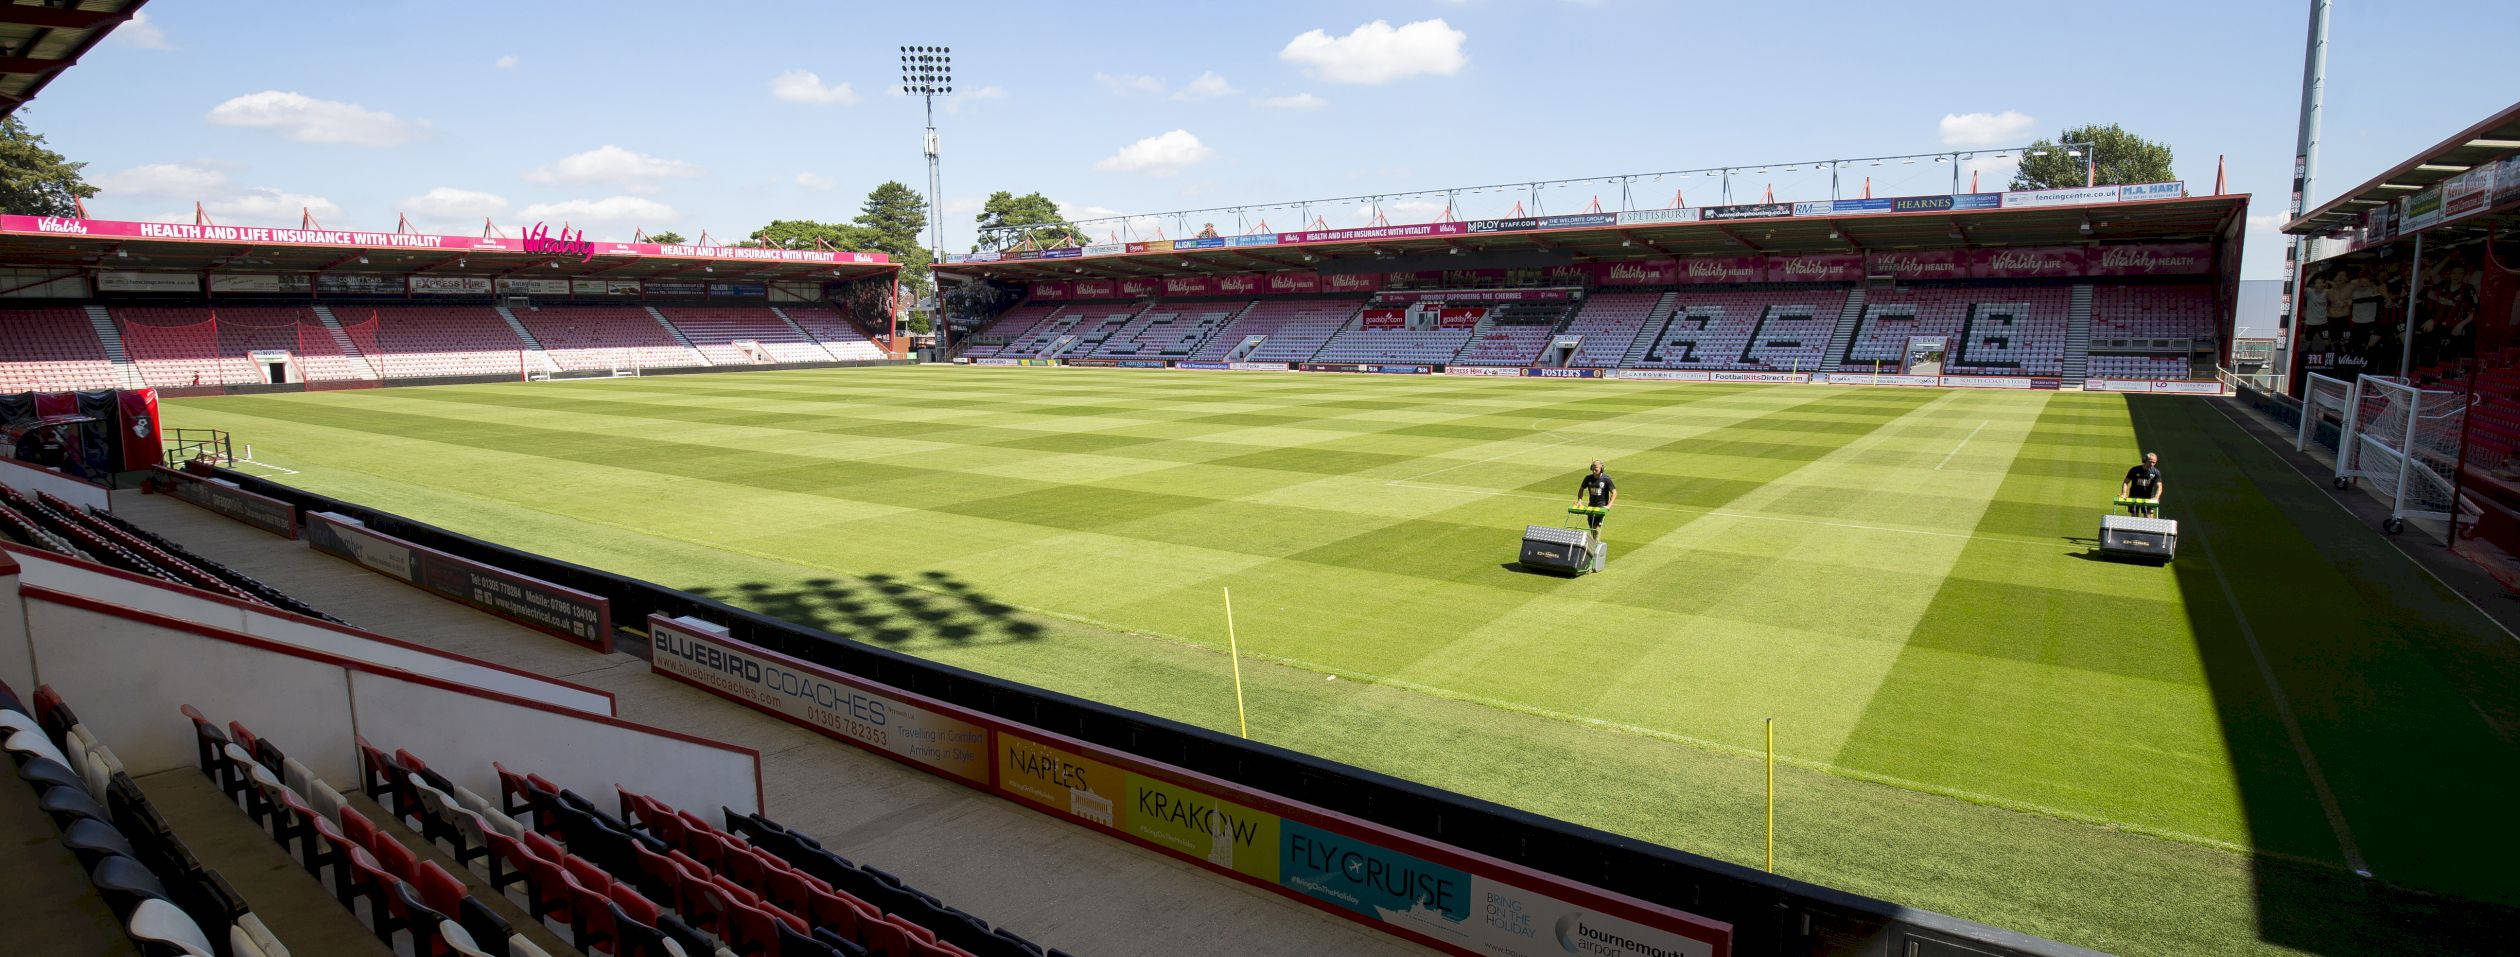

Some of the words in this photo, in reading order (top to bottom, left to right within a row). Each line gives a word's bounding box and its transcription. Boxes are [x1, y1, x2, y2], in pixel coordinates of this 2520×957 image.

[2035, 189, 2116, 202] fencingcentre.co.uk
[2149, 181, 2180, 194] HART
[1897, 199, 1951, 210] HEARNES
[37, 217, 88, 236] Vitality
[140, 223, 202, 239] HEALTH
[204, 226, 237, 240] AND
[240, 228, 269, 241] LIFE
[273, 230, 351, 245] INSURANCE
[353, 233, 387, 246] WITH
[388, 234, 441, 248] VITALITY
[1306, 231, 1328, 241] HEALTH
[1328, 230, 1340, 240] AND
[1341, 229, 1353, 239] LIFE
[1354, 228, 1387, 239] INSURANCE
[1387, 226, 1404, 237] WITH
[1404, 225, 1431, 236] VITALITY
[522, 221, 595, 263] Vitality
[660, 245, 694, 256] HEALTH
[696, 247, 714, 257] AND
[717, 247, 733, 258] LIFE
[735, 248, 780, 260] INSURANCE
[781, 250, 803, 261] WITH
[803, 251, 834, 262] VITALITY
[1992, 251, 2042, 274] Vitality
[2045, 260, 2061, 268] LIFE
[2102, 248, 2157, 272] Vitality
[2159, 256, 2194, 266] HEALTH
[1610, 263, 1647, 283] Vitality
[1688, 260, 1728, 281] Vitality
[1785, 257, 1828, 279] Vitality
[1878, 254, 1923, 276] Vitality
[1924, 263, 1955, 271] HEALTH
[415, 277, 461, 289] EXPRESS
[463, 277, 486, 289] HIRE
[1421, 293, 1445, 301] PROUDLY
[1447, 292, 1480, 300] SUPPORTING
[1482, 292, 1493, 300] THE
[1495, 291, 1521, 300] CHERRIES
[1541, 367, 1581, 377] FOSTER'S
[2338, 354, 2368, 369] Vitality
[1715, 373, 1803, 382] FootballKitsDirect.com
[525, 589, 550, 608] Mobile:
[572, 604, 598, 623] 134104
[655, 629, 761, 684] BLUEBIRD
[766, 667, 886, 726] COACHES
[656, 655, 782, 709] www.bluebirdcoaches.com
[807, 705, 841, 731] 01305
[843, 717, 888, 746] 782353
[898, 725, 936, 743] Travelling
[948, 730, 984, 745] Comfort
[910, 744, 941, 761] Arriving
[953, 749, 976, 762] Style
[1009, 746, 1088, 791] NAPLES
[1139, 786, 1258, 849] KRAKOW
[1291, 833, 1338, 874] FLY
[1341, 851, 1454, 913] CRUISE
[1291, 874, 1361, 906] #BringOnTheHoliday
[1487, 891, 1522, 912] BRING
[1487, 904, 1506, 919] ON
[1510, 909, 1531, 925] THE
[1486, 914, 1537, 939] HOLIDAY
[1578, 921, 1685, 957] bournemout
